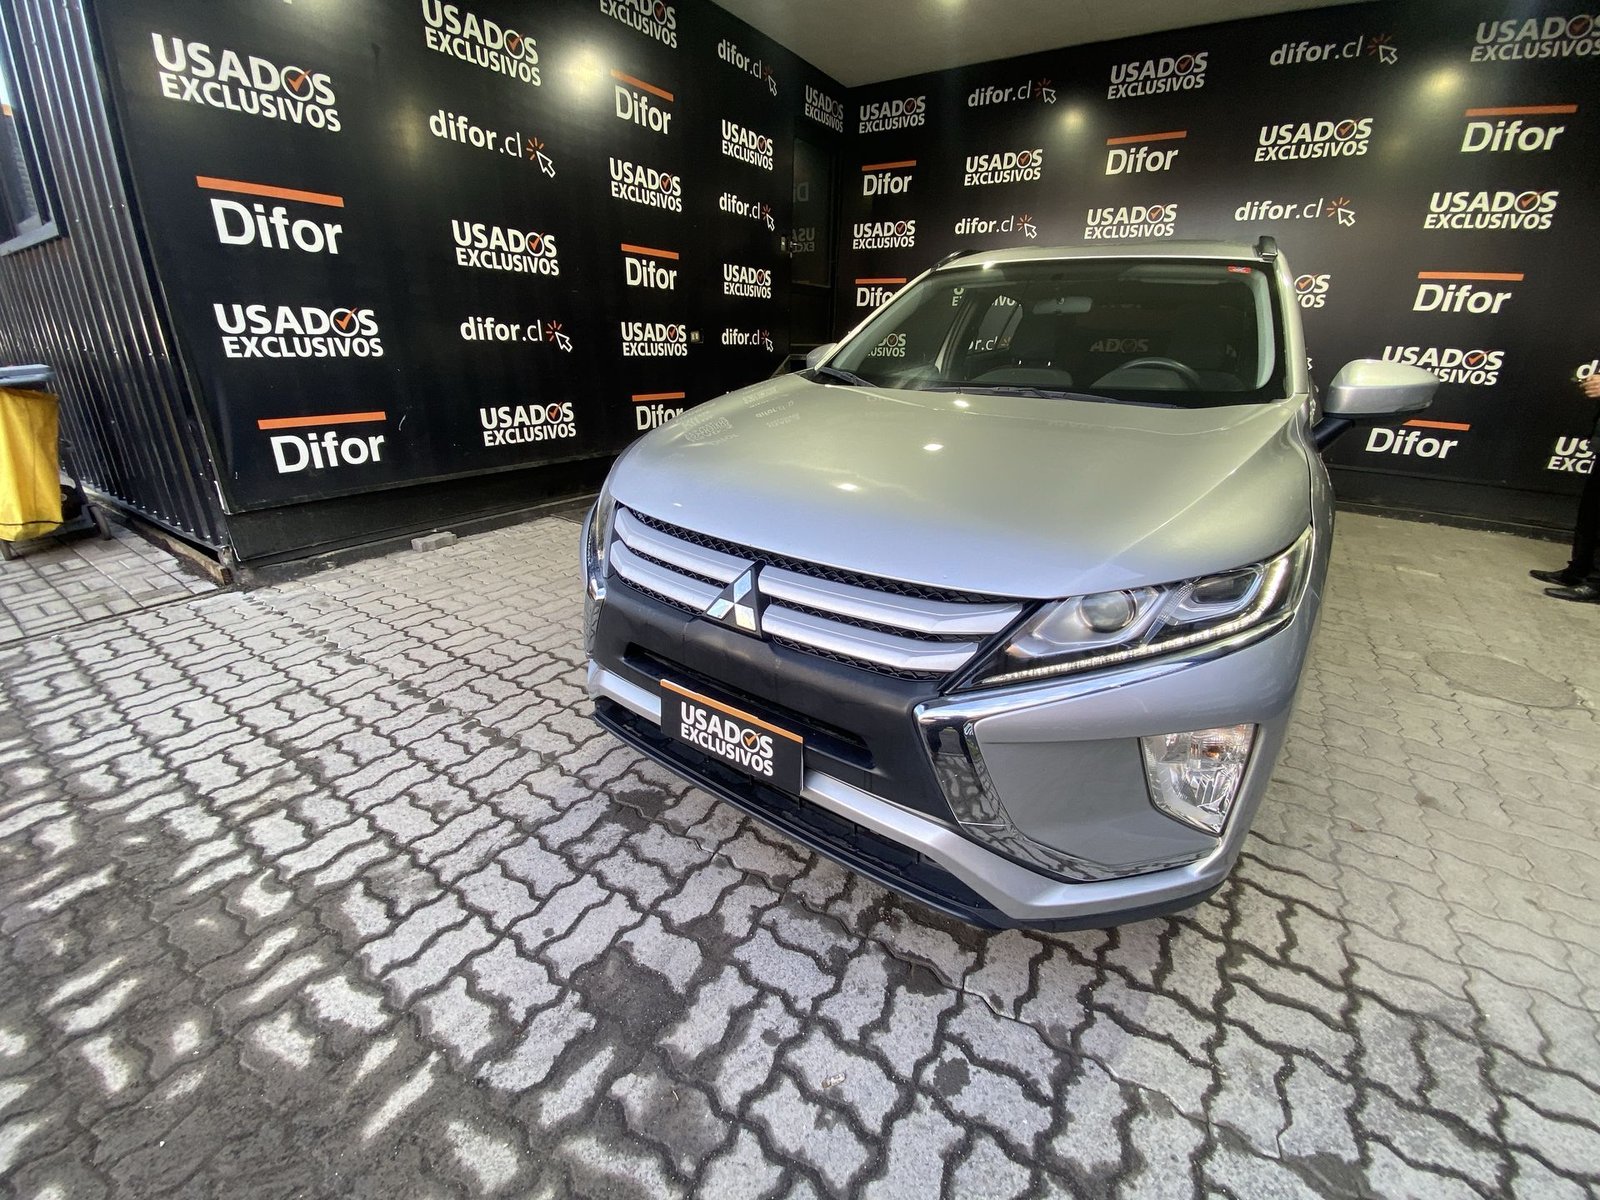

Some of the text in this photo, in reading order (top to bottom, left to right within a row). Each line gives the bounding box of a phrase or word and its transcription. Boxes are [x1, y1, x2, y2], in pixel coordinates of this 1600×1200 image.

[422, 0, 538, 64] USADOS
[600, 0, 678, 48] EXCLUSIVOS
[425, 26, 541, 86] EXCLUSIVOS
[718, 39, 762, 79] difor.cl
[1270, 35, 1363, 66] difor.cl
[152, 33, 335, 106] USADOS
[1110, 52, 1208, 84] USADOS
[968, 80, 1032, 108] difor.cl
[1107, 74, 1205, 100] EXCLUSIVOS
[159, 72, 341, 131] EXCLUSIVOS
[614, 85, 671, 134] Difor
[806, 84, 844, 120] USADOS
[860, 96, 926, 120] USADOS
[804, 103, 843, 132] EXCLUSIVOS
[859, 114, 926, 134] EXCLUSIVOS
[430, 110, 522, 158] difor.cl
[722, 119, 773, 156] USADOS
[1258, 118, 1374, 146] USADOS
[1461, 120, 1564, 152] Difor
[722, 140, 773, 170] EXCLUSIVOS
[966, 149, 1043, 172] USADOS
[1105, 146, 1178, 175] Difor
[1254, 140, 1368, 162] EXCLUSIVOS
[610, 158, 682, 196] USADOS
[863, 173, 912, 196] Difor
[964, 167, 1041, 186] EXCLUSIVOS
[611, 180, 682, 212] EXCLUSIVOS
[719, 192, 760, 220] difor.cl
[1234, 198, 1324, 222] difor.cl
[1428, 191, 1560, 213] USADOS
[211, 198, 342, 254] Difor
[854, 220, 916, 238] USADOS
[954, 216, 1014, 234] difor.cl
[1086, 204, 1178, 226] USADOS
[1424, 214, 1553, 230] EXCLUSIVOS
[452, 220, 557, 258] USADOS
[852, 236, 915, 250] EXCLUSIVOS
[1084, 223, 1174, 240] EXCLUSIVOS
[456, 247, 560, 276] EXCLUSIVOS
[625, 256, 677, 290] Difor
[724, 264, 772, 286] USADOS
[724, 282, 772, 299] EXCLUSIVOS
[856, 287, 894, 306] Difo
[1412, 284, 1512, 314] Difor
[213, 304, 378, 337] USADOS
[460, 317, 542, 342] difor.cl
[621, 322, 687, 342] USADOS
[222, 336, 384, 358] EXCLUSIVOS
[622, 342, 688, 356] EXCLUSIVOS
[722, 328, 760, 346] difor.cl
[1381, 346, 1504, 370] USADOS
[480, 402, 574, 430] USADOS
[483, 422, 576, 446] EXCLUSIVOS
[1365, 427, 1458, 459] Difor
[270, 431, 385, 474] Difor
[681, 702, 774, 758] USADOS
[680, 722, 774, 776] EXCLUSIVOS
